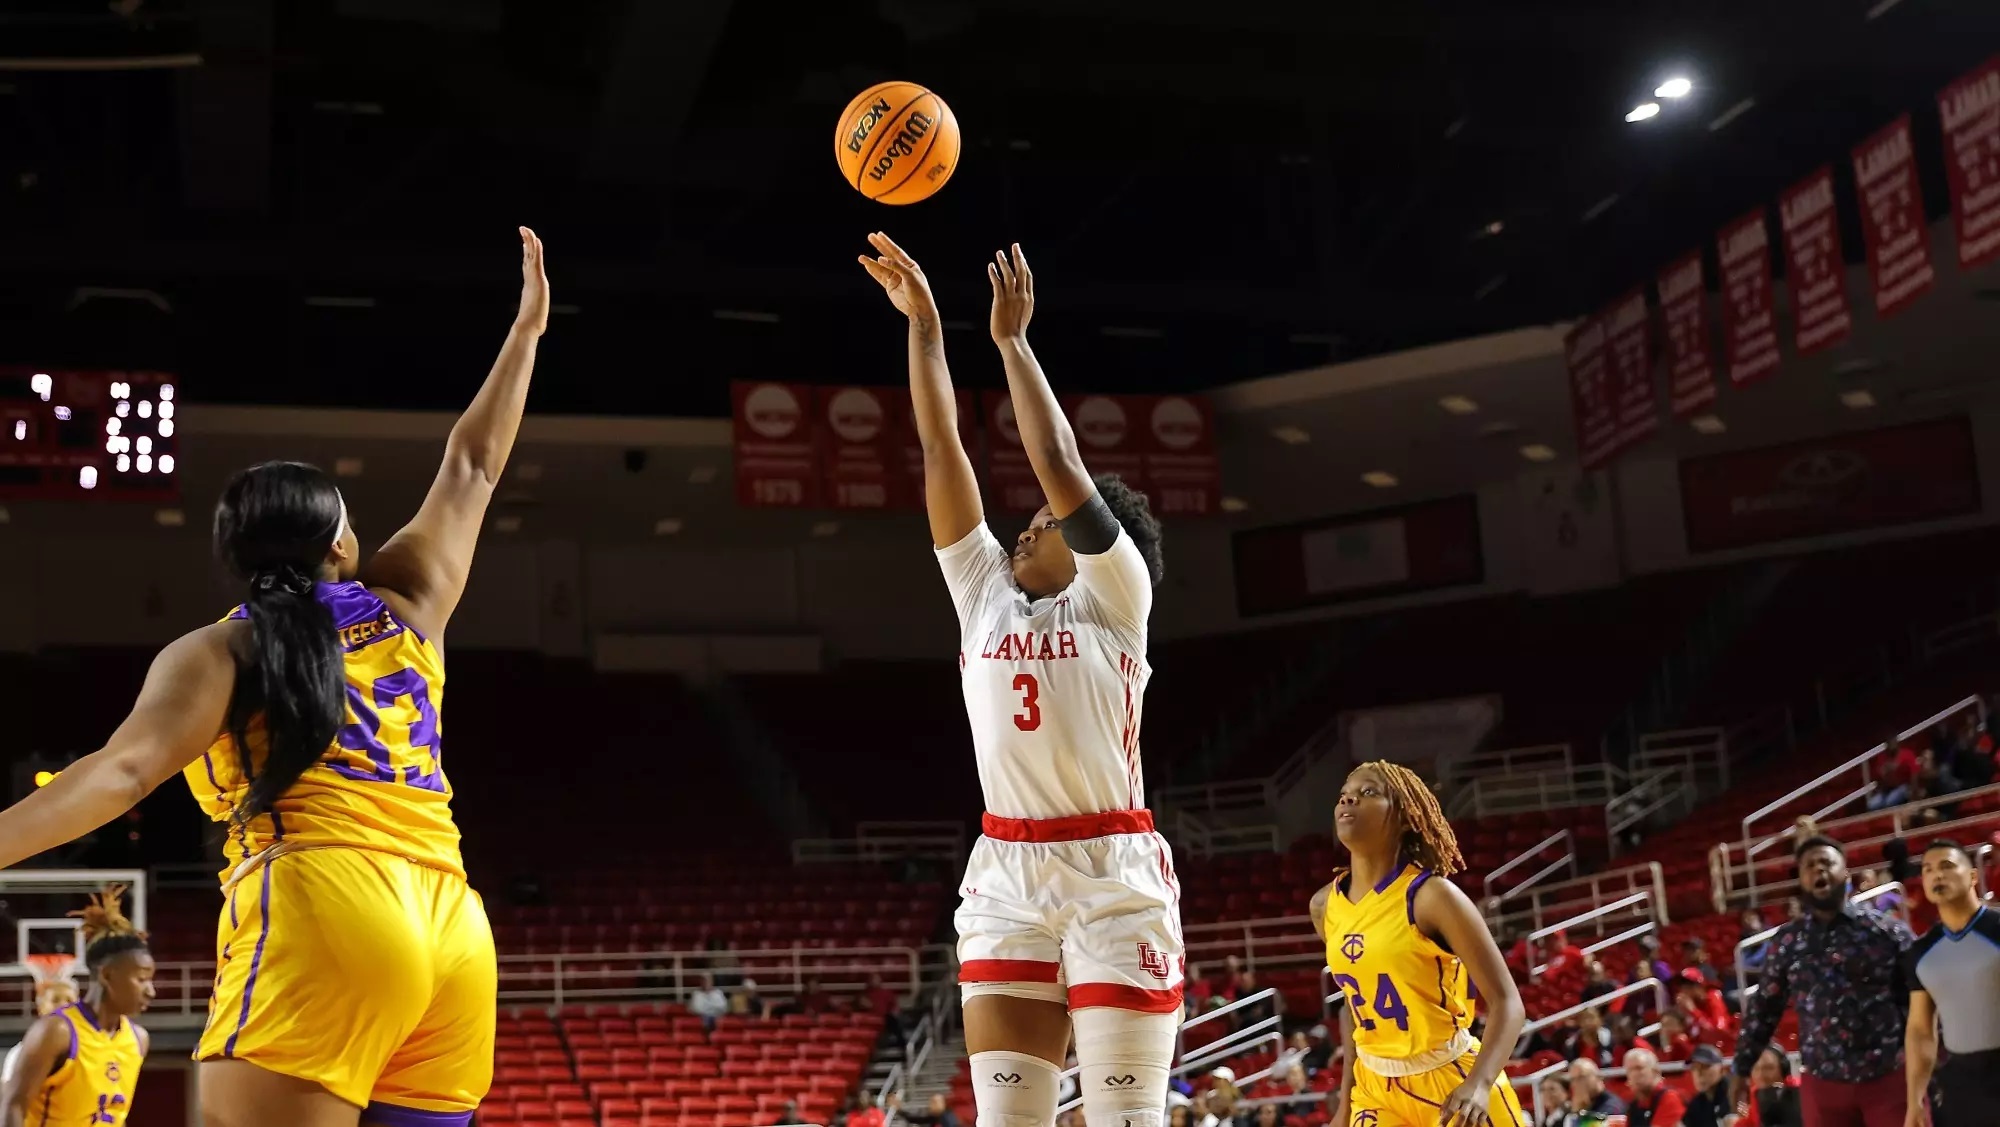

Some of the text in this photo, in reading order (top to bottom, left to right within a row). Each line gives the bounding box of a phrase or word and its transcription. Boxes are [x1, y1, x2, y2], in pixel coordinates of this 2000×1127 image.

[848, 97, 892, 154] NCAA
[868, 111, 934, 181] Wilson
[981, 630, 1080, 661] LAMAR
[1012, 673, 1041, 732] 3
[1137, 942, 1170, 980] LU
[1333, 973, 1409, 1031] 24
